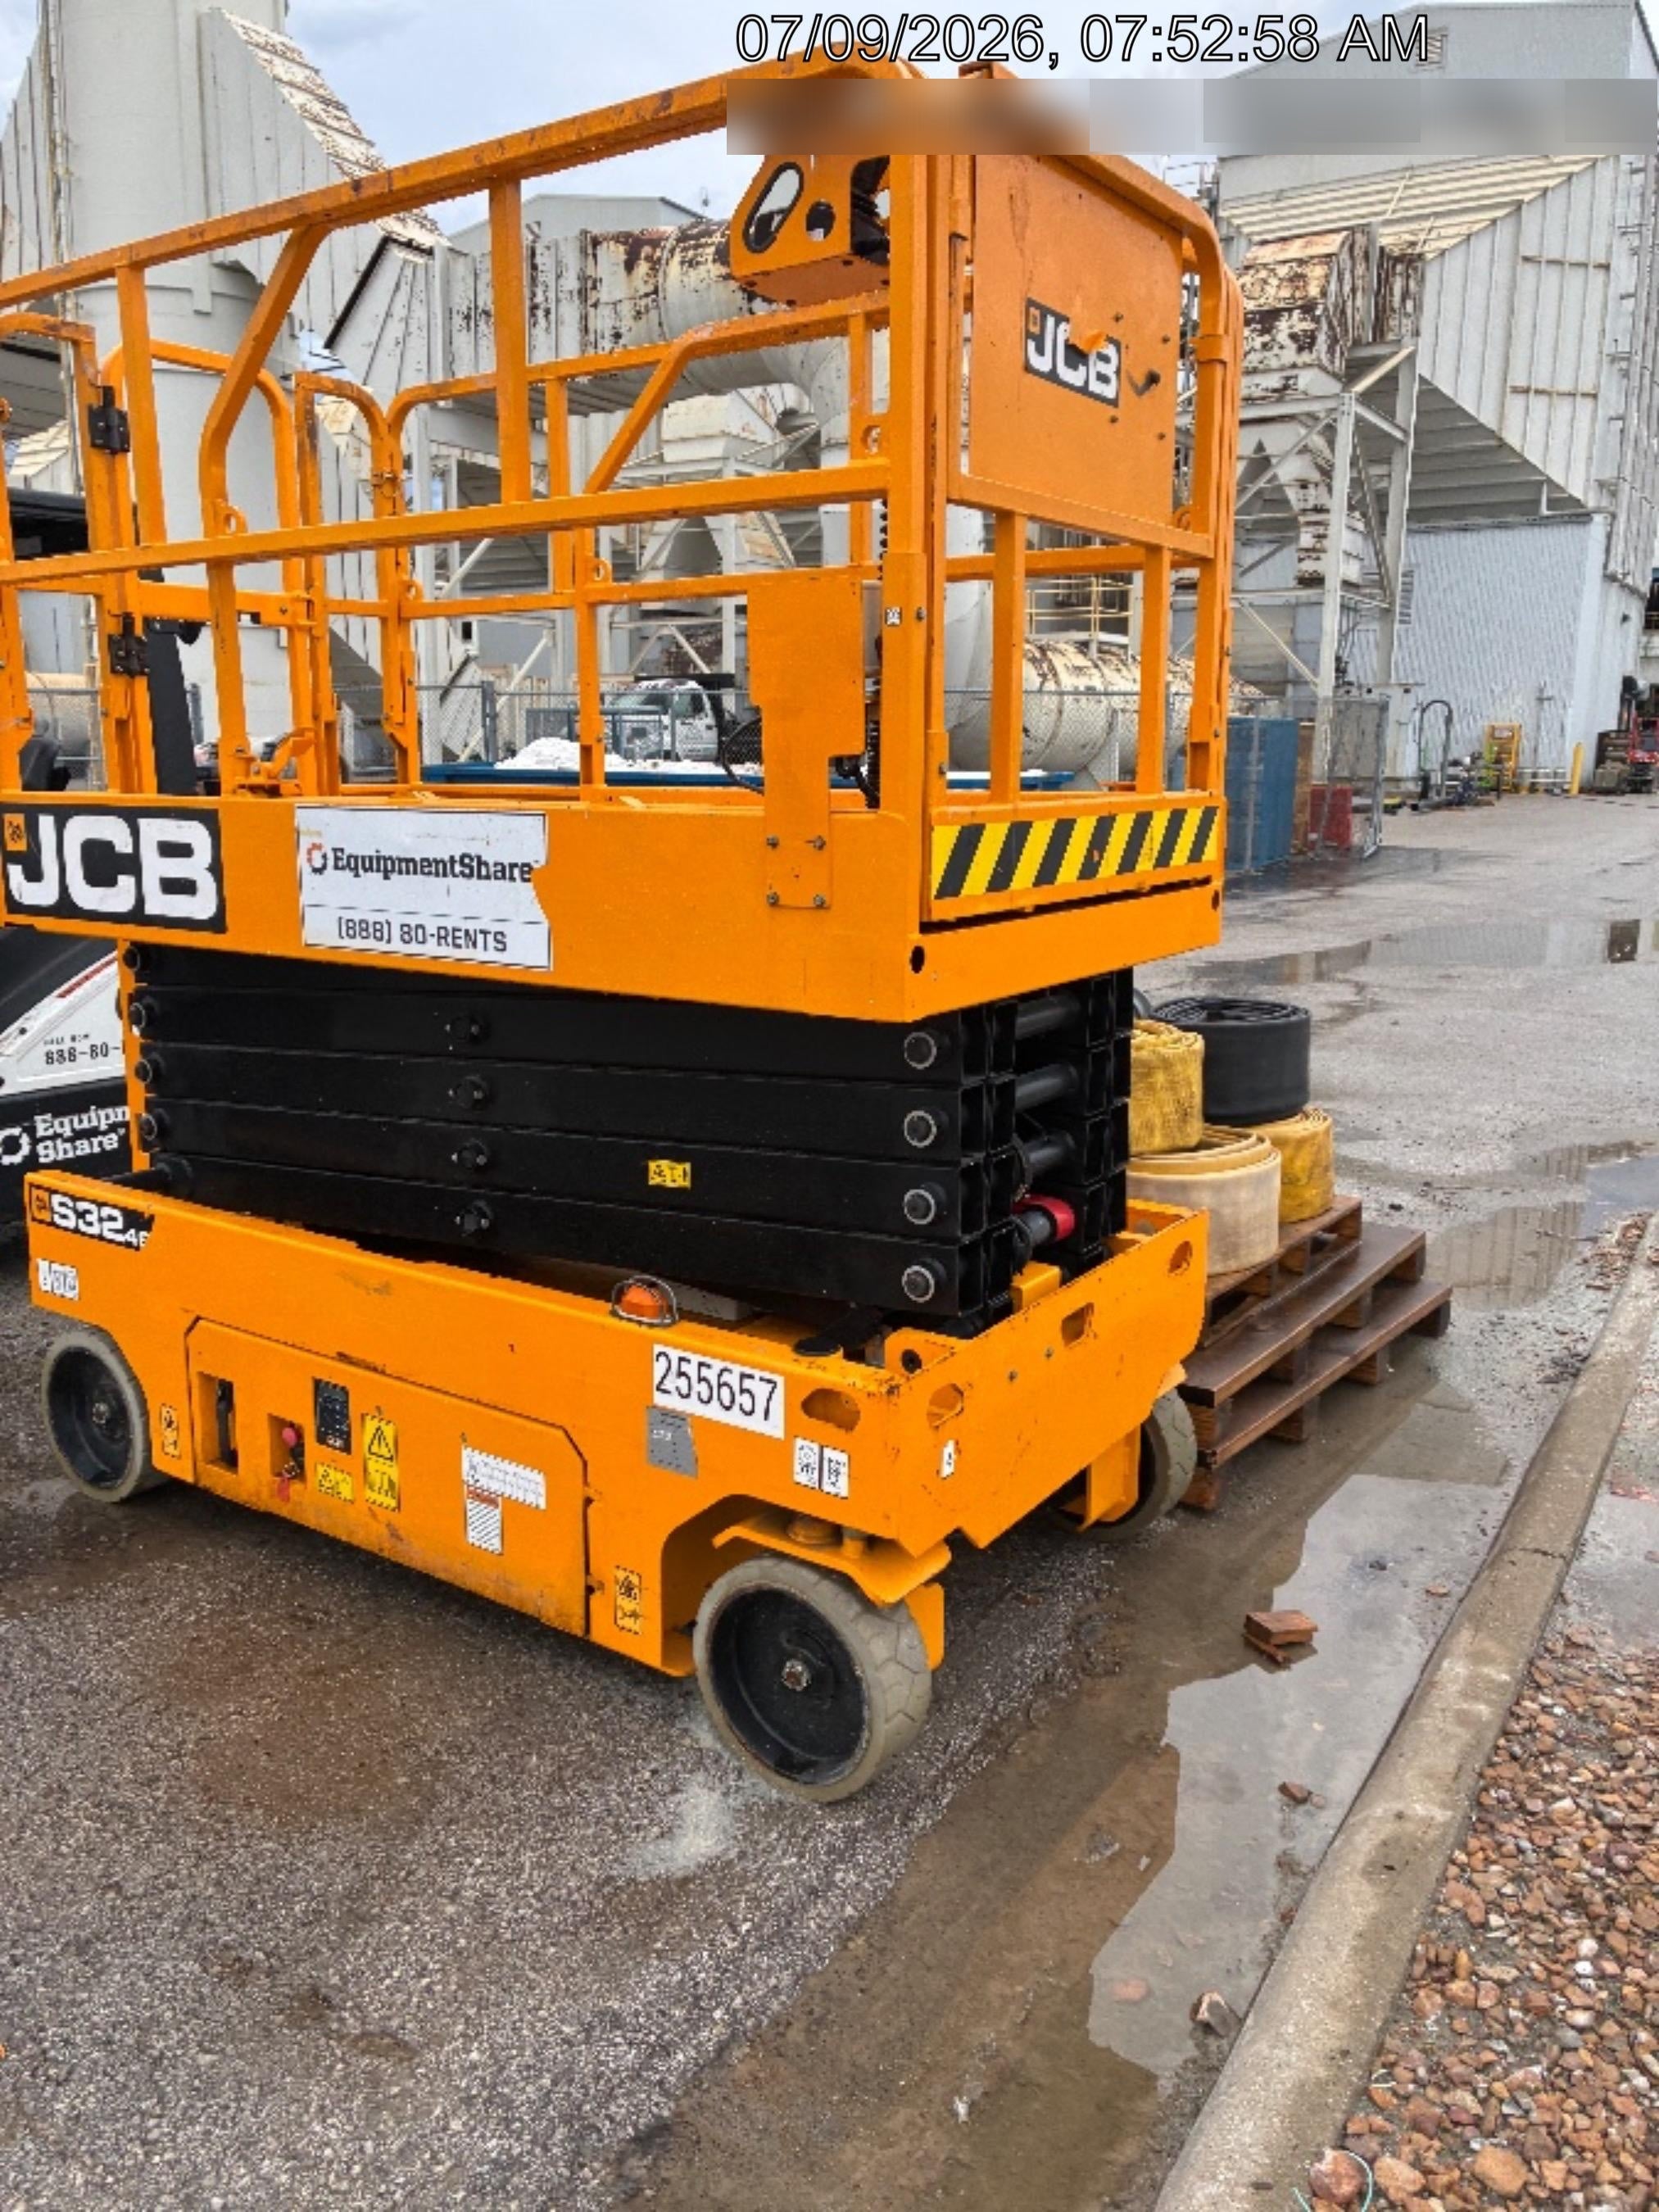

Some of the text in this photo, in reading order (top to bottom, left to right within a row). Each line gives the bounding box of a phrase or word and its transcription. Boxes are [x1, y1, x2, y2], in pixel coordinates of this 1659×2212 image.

[1027, 314, 1119, 399] JCB
[7, 814, 219, 920] JCB
[331, 847, 533, 883] EquipmentShare
[338, 916, 508, 953] (888) 80-RENTS
[45, 1041, 125, 1066] 888-80-
[37, 1131, 119, 1163] Share
[655, 1351, 777, 1421] 255657
